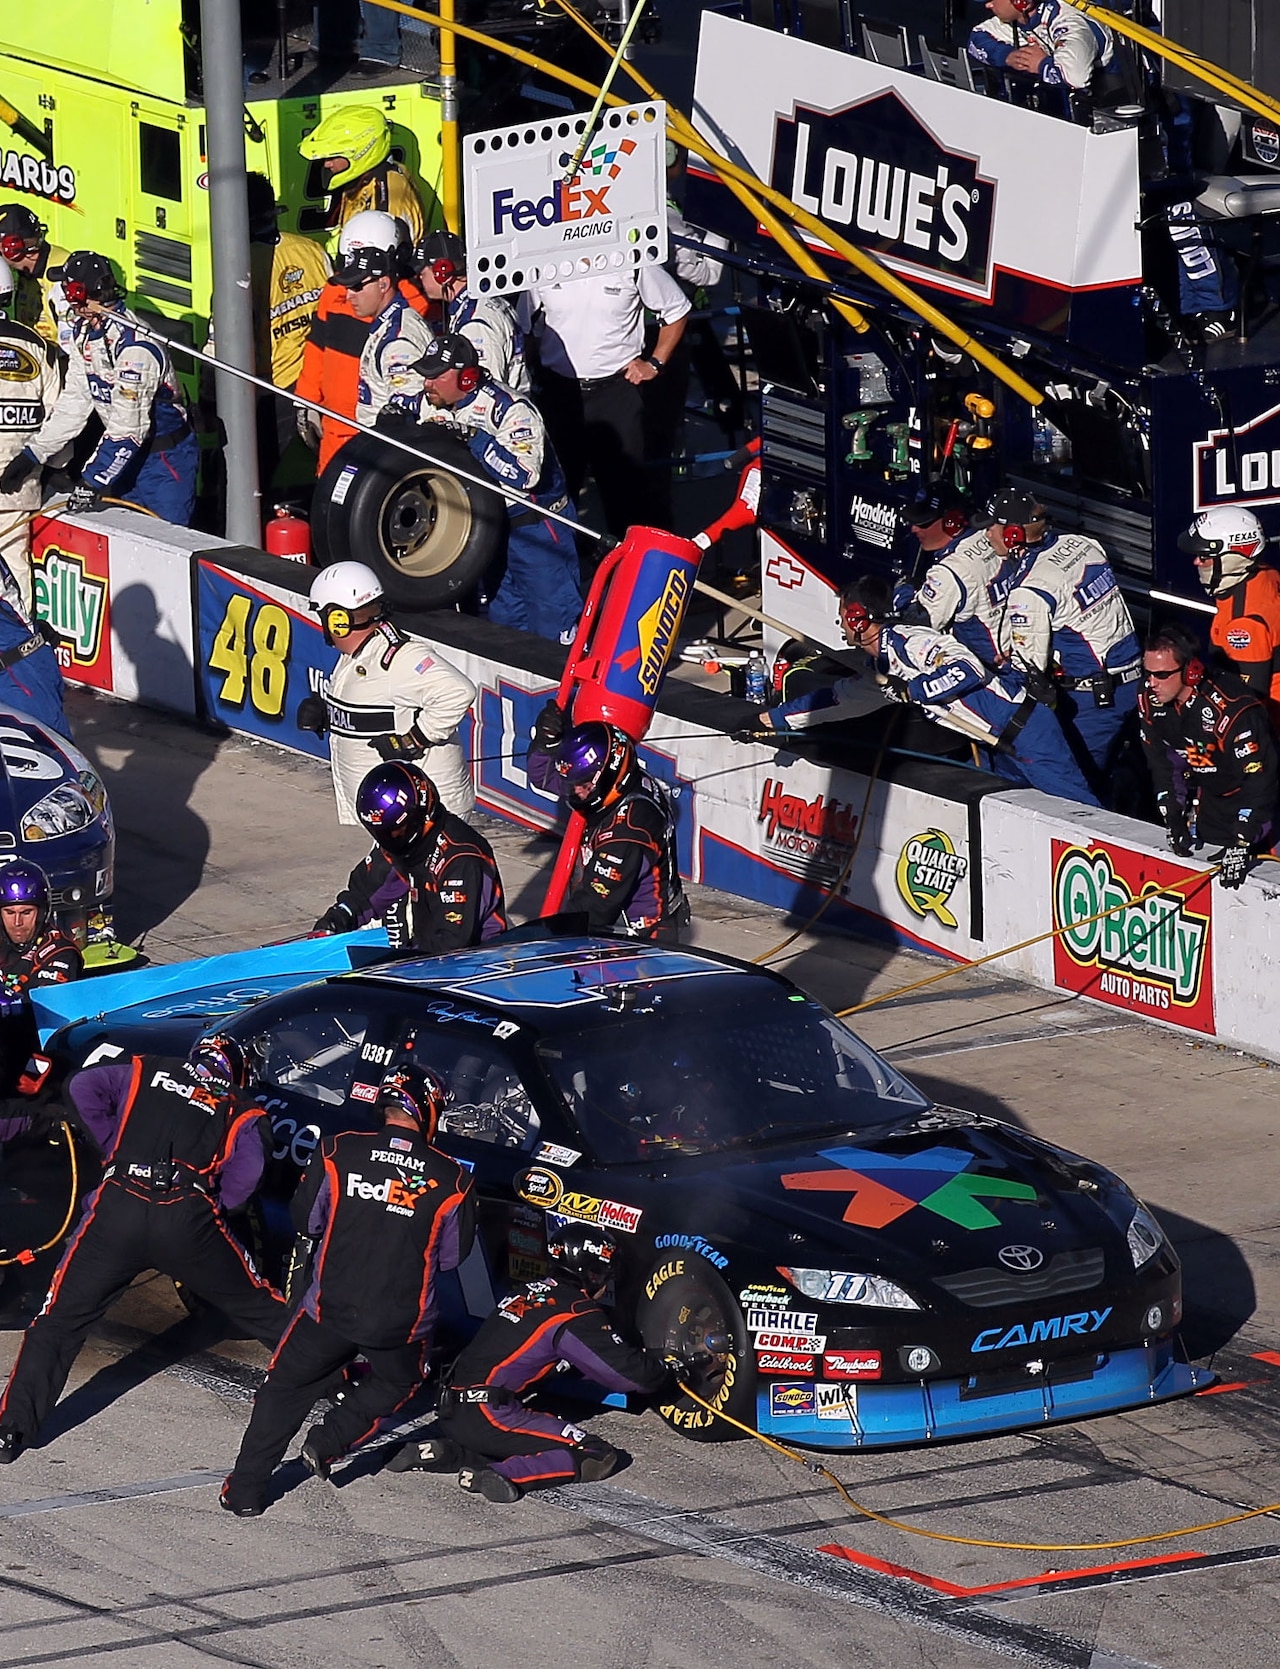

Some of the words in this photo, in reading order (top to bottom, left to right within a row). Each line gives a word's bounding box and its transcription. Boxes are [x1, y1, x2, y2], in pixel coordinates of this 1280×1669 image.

[492, 176, 612, 235] FedEx
[791, 122, 973, 262] LOWE'S
[562, 220, 614, 242] RACING
[850, 495, 898, 529] Hendrick
[963, 536, 991, 561] PUCH
[1228, 530, 1260, 543] TEXAS
[1048, 536, 1083, 566] MICHEL
[35, 560, 97, 650] eilly
[641, 571, 687, 695] SUNOCO
[209, 593, 291, 716] 48
[923, 666, 967, 698] LOWE'S
[761, 778, 859, 843] Hendrick
[594, 861, 623, 882] FedEx
[906, 839, 969, 877] QUAKER
[913, 866, 957, 893] STATE
[439, 890, 468, 903] FedEx
[1062, 861, 1198, 990] O'Reilly
[1100, 972, 1131, 999] AUTO
[1132, 982, 1171, 1010] PARTS
[361, 1042, 394, 1067] 0381
[150, 1070, 222, 1109] FedEx
[187, 1098, 217, 1116] RACING
[369, 1150, 426, 1173] PEGRAM
[346, 1172, 421, 1210] FedEx
[527, 1182, 548, 1195] Sprint
[385, 1204, 415, 1218] RACING
[600, 1200, 639, 1230] Holley
[654, 1233, 730, 1271] GOODYEAR
[645, 1260, 685, 1300] EAGLE
[826, 1274, 867, 1300] 11
[739, 1290, 792, 1306] Gatorback
[749, 1311, 817, 1331] MAHLE
[970, 1306, 1113, 1354] CAMRY
[758, 1333, 809, 1349] COMP
[757, 1354, 815, 1373] Edelbrock
[775, 1392, 814, 1402] SUNOCO
[818, 1386, 853, 1408] WIX
